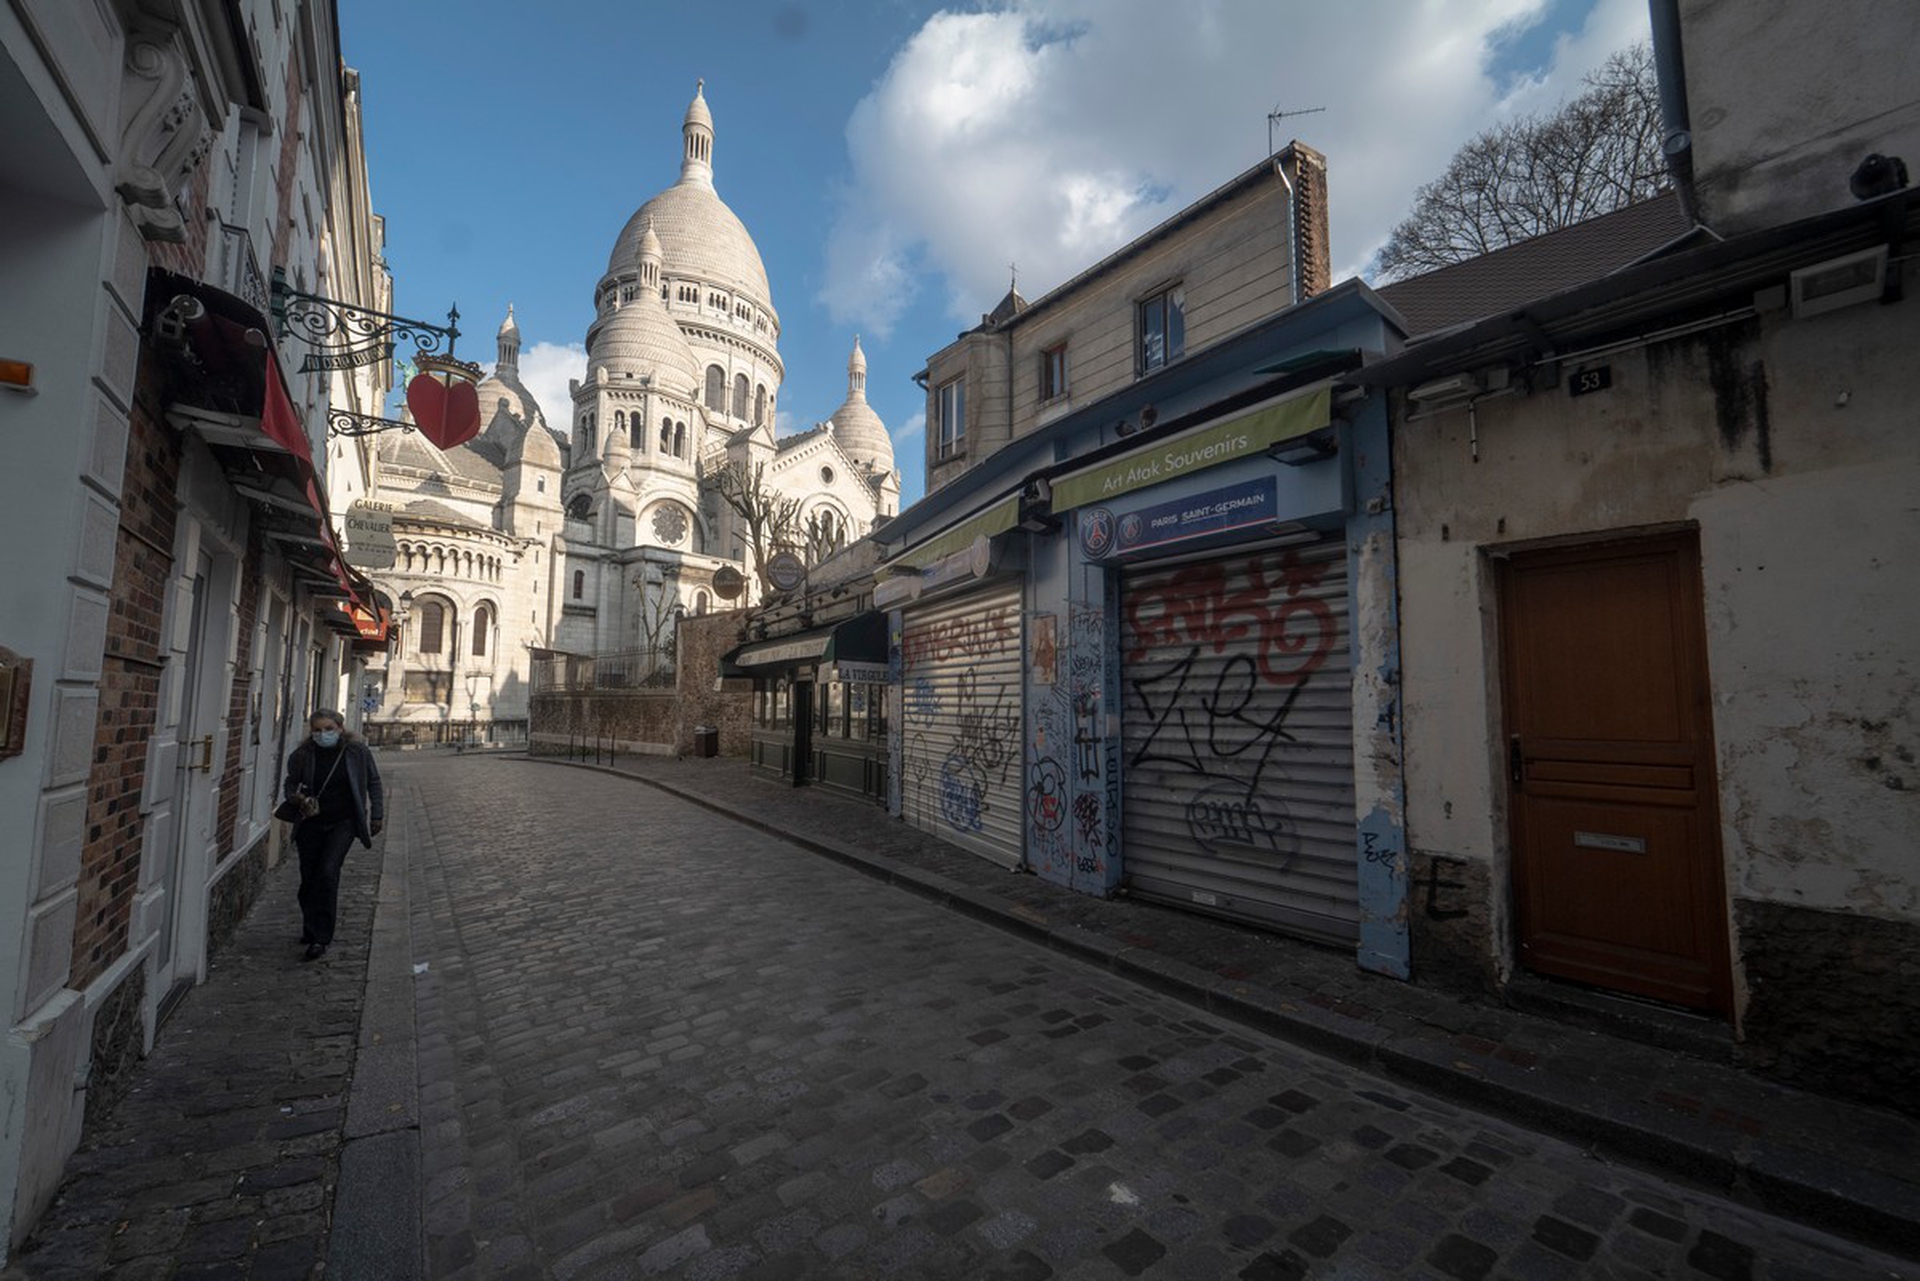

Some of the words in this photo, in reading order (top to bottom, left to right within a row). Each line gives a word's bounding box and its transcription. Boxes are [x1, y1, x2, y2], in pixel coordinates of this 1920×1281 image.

[1580, 371, 1601, 392] 53
[1102, 475, 1123, 493] Art
[1126, 461, 1160, 486] Atak
[1164, 435, 1248, 472] Souvenirs
[354, 498, 393, 512] GALERIE
[1150, 514, 1178, 529] PARIS
[1181, 493, 1265, 521] SAINT-GERMAIN
[347, 518, 391, 533] CHEVALIER
[838, 667, 851, 680] LA
[852, 668, 889, 683] VIRGULE
